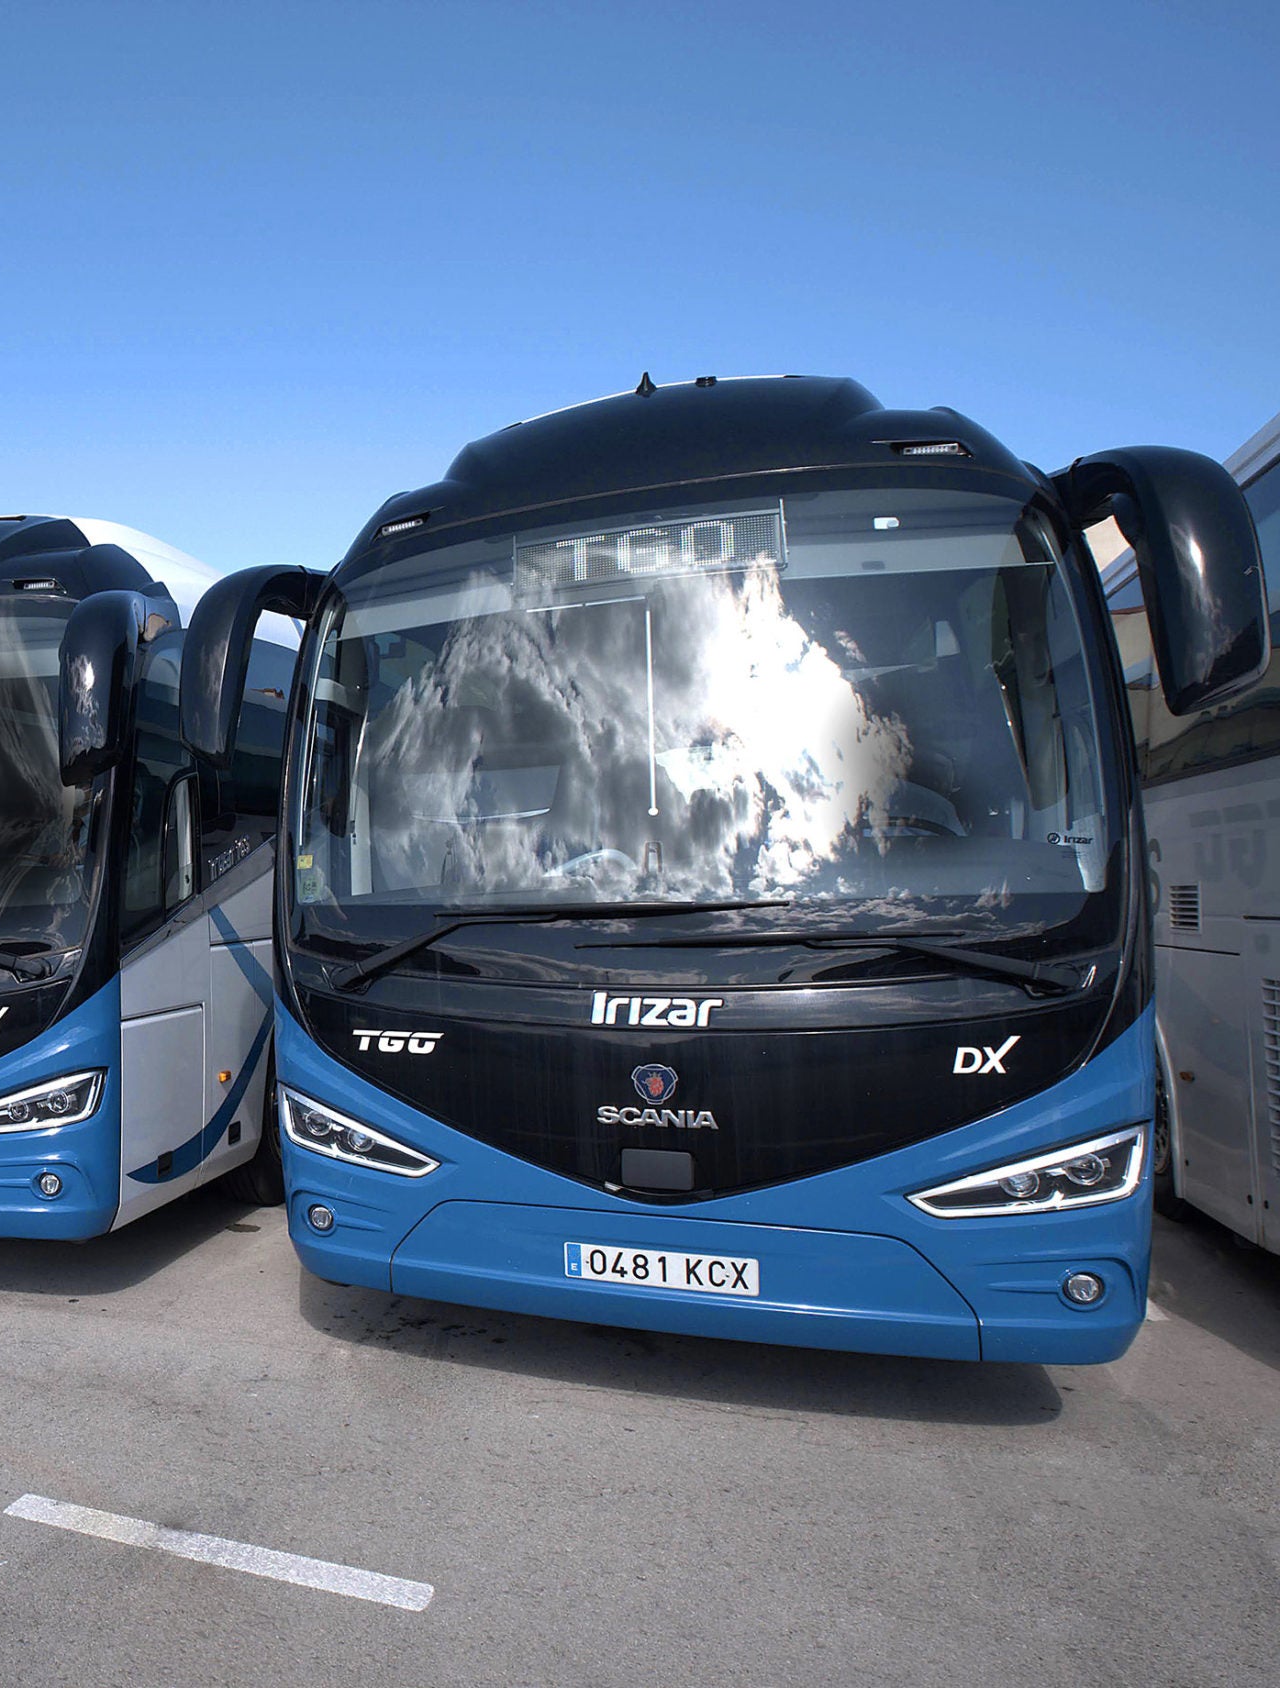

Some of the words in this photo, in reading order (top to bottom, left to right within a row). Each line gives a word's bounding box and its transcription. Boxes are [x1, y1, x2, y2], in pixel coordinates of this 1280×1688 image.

[556, 520, 735, 582] TGO
[591, 990, 724, 1028] Irizar
[351, 1029, 445, 1055] TGO
[952, 1034, 1022, 1075] DX
[596, 1105, 719, 1130] SCANIA
[589, 1248, 670, 1283] 0481
[684, 1257, 750, 1291] KCX
